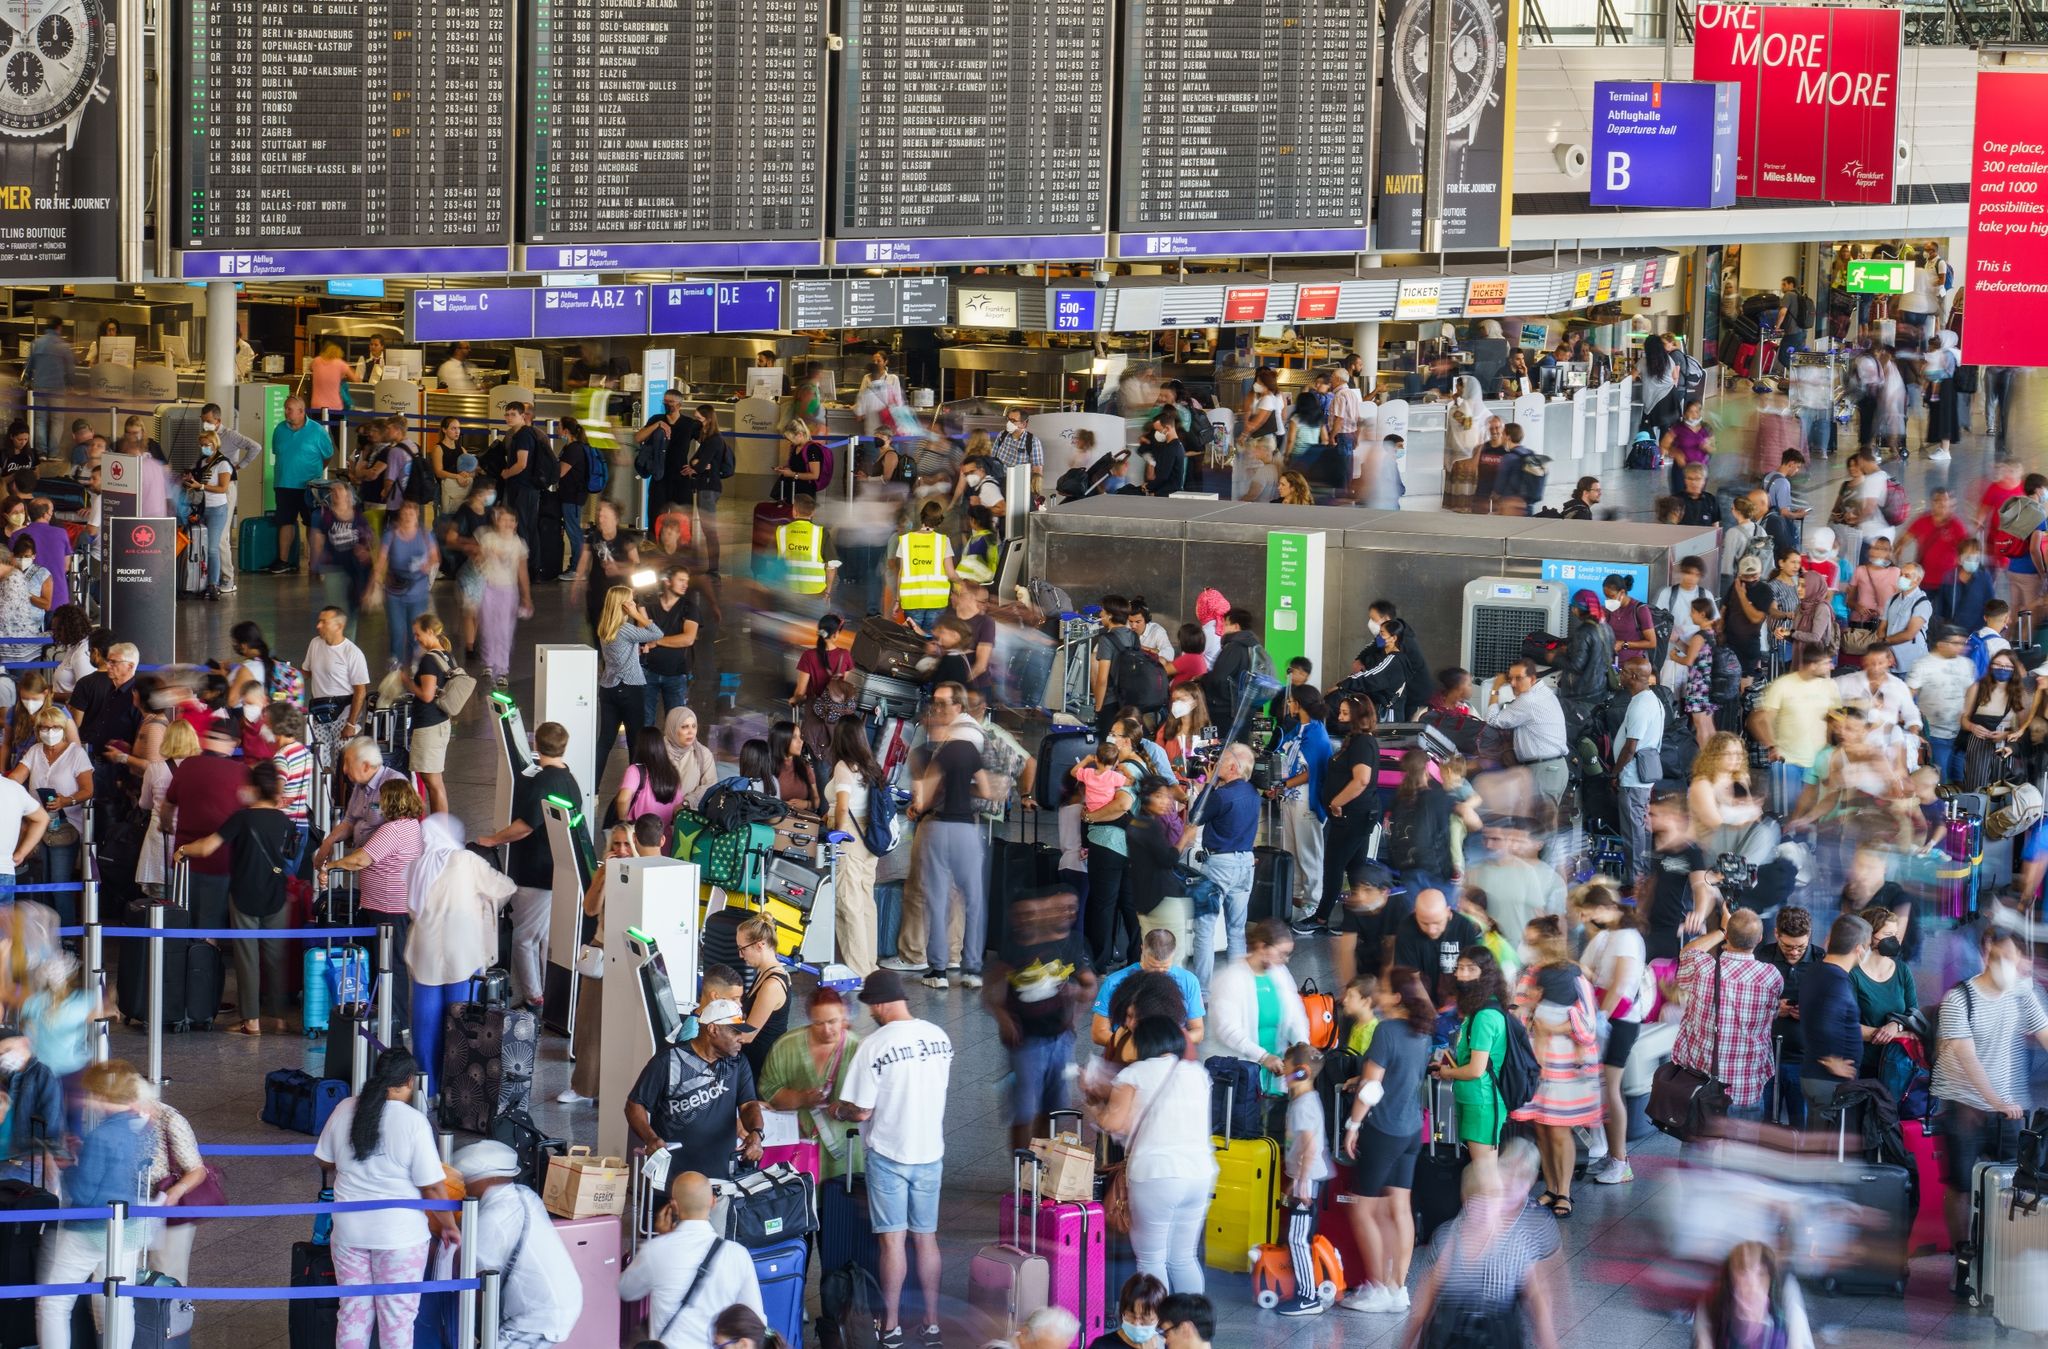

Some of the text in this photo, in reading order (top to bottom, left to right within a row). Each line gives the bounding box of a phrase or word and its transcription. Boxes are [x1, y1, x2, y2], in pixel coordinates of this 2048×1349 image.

[263, 4, 287, 12] PARIS
[313, 5, 322, 13] DE
[329, 6, 357, 14] GAULLE
[263, 16, 282, 25] RIFA
[263, 29, 352, 38] BERLIN-BRANDENBURG
[263, 42, 352, 50] KOPENHAGEN-KASTRUP
[1731, 33, 1824, 68] MORE
[262, 66, 286, 75] BASEL
[262, 79, 292, 87] DUBLIN
[1795, 71, 1890, 107] MORE
[211, 91, 297, 99] LH 440 HOUSTON
[1609, 91, 1659, 102] Terminal 1
[237, 116, 250, 124] 696
[262, 116, 286, 124] ERBIL
[1608, 110, 1660, 122] Abflughalle
[262, 128, 291, 136] ZAGREB
[1607, 124, 1677, 135] Departures hall
[262, 140, 326, 149] STUTTGART HBF
[1983, 141, 2045, 156] One place,
[262, 153, 306, 161] KOELN HBF
[262, 165, 361, 173] GOETTINGEN-KASSEL BH
[1607, 152, 1630, 190] B
[1982, 161, 2005, 173] 300
[1714, 154, 1722, 192] B
[1763, 172, 1816, 183] Miles & More
[1857, 171, 1884, 180] Frankfurt
[1446, 184, 1496, 193] FOR THE JOURNEY
[1981, 181, 2037, 193] and 1000
[210, 190, 290, 198] LH 334 NEAPEL
[35, 198, 52, 209] FOR
[55, 198, 70, 209] THE
[72, 198, 110, 209] JOURNEY
[262, 202, 316, 210] DALLAS-FORT
[1979, 201, 2044, 215] possibilities
[262, 214, 286, 222] KAIRO
[261, 226, 301, 235] BORDEAUX
[1978, 221, 2003, 232] take
[2005, 223, 2027, 235] you
[26, 227, 67, 239] BOUTIQUE
[11, 242, 38, 250] FRANKFURT
[893, 243, 910, 252] Abflug
[1172, 245, 1196, 253] Departures
[589, 250, 607, 258] Abflug
[893, 252, 920, 260] Departures
[253, 255, 273, 265] Abflug
[589, 259, 618, 267] Departures
[253, 265, 285, 274] Departures
[1977, 260, 2011, 272] This is
[683, 288, 705, 296] Terminal
[720, 287, 740, 305] D,E
[1404, 287, 1438, 297] TICKETS
[1473, 289, 1504, 297] TICKETS
[448, 293, 488, 311] Abflug C
[560, 290, 624, 309] Abflug A,B,Z
[1060, 303, 1086, 314] 500-
[1060, 316, 1079, 327] 570
[788, 543, 809, 551] Crew
[912, 558, 932, 566] Crew
[668, 1079, 730, 1115] Reebok
